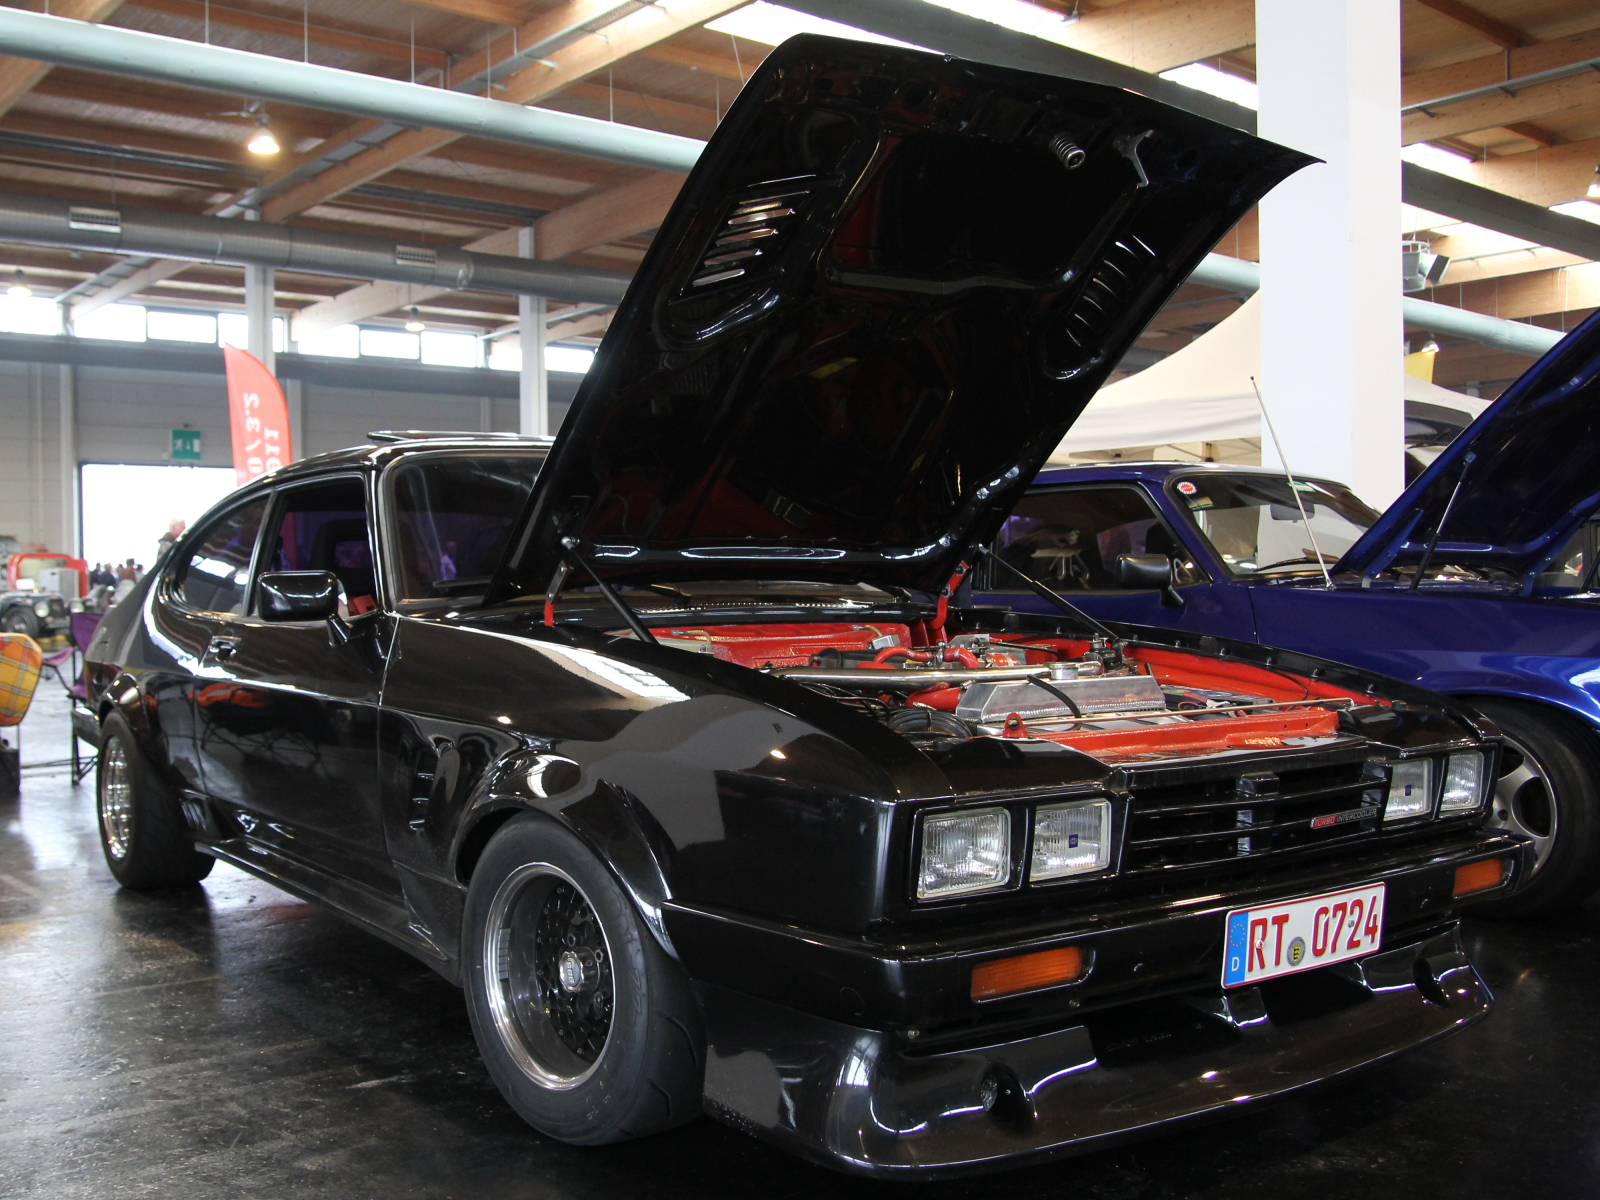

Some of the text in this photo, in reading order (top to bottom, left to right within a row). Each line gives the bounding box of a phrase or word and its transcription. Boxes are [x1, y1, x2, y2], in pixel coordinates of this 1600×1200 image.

[1314, 808, 1377, 828] TURBO INTERCOOLER
[1231, 894, 1378, 973] D RT 0724
